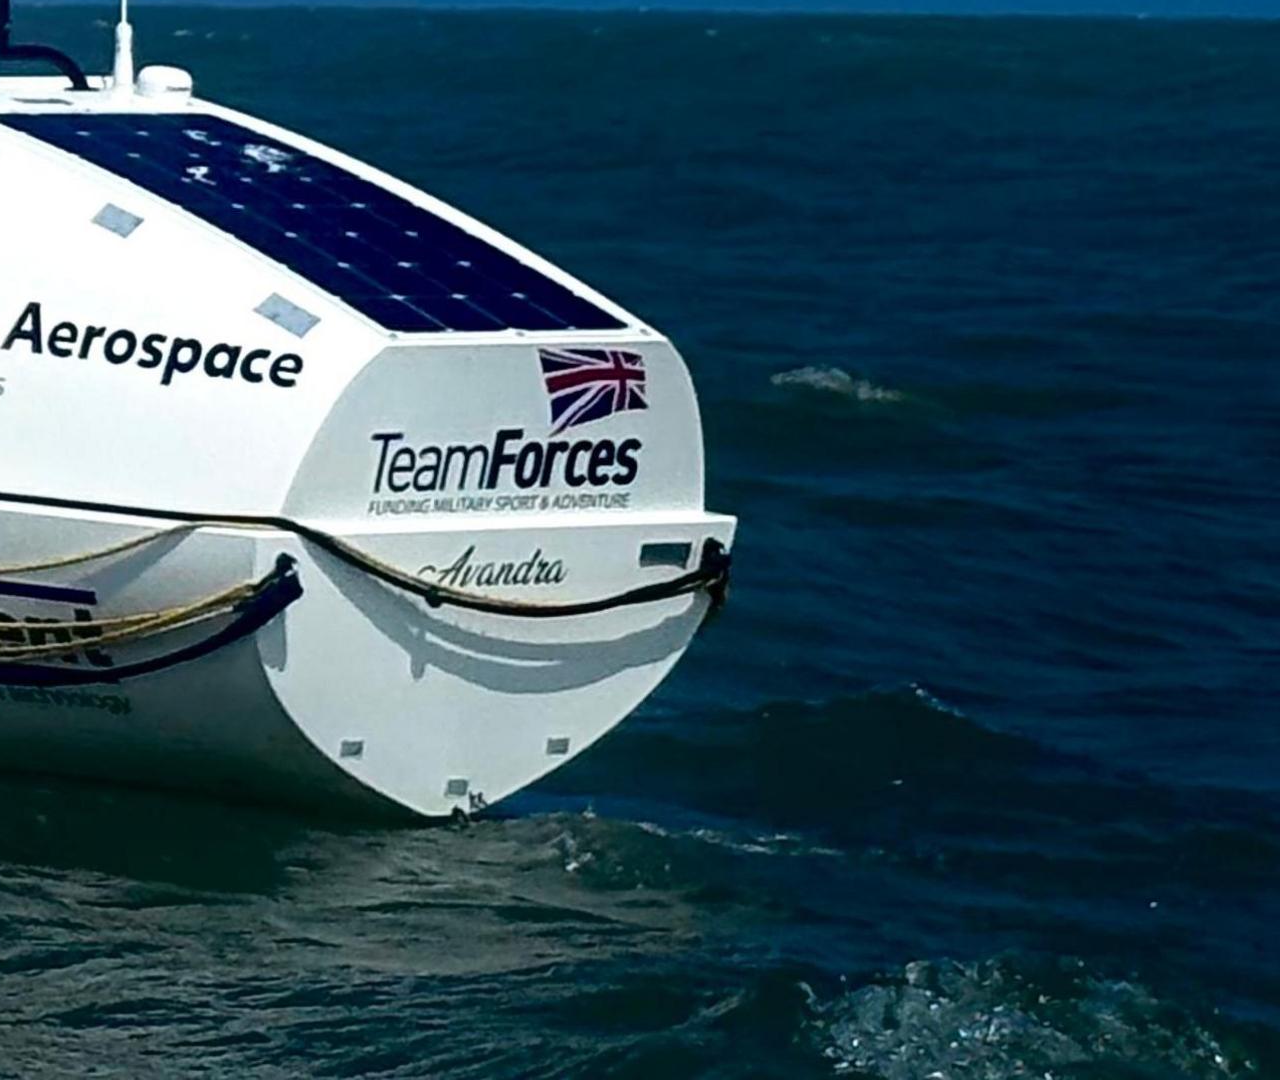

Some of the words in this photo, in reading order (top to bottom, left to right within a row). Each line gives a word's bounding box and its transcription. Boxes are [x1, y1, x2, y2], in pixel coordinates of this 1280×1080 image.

[0, 301, 305, 388] Aerospace
[370, 428, 642, 494] TeamForces
[367, 497, 432, 517] FUNDING
[432, 495, 494, 515] MILITARY
[494, 493, 539, 512] SPORT
[551, 491, 631, 511] ADVENTURE
[418, 544, 567, 588] Avandra
